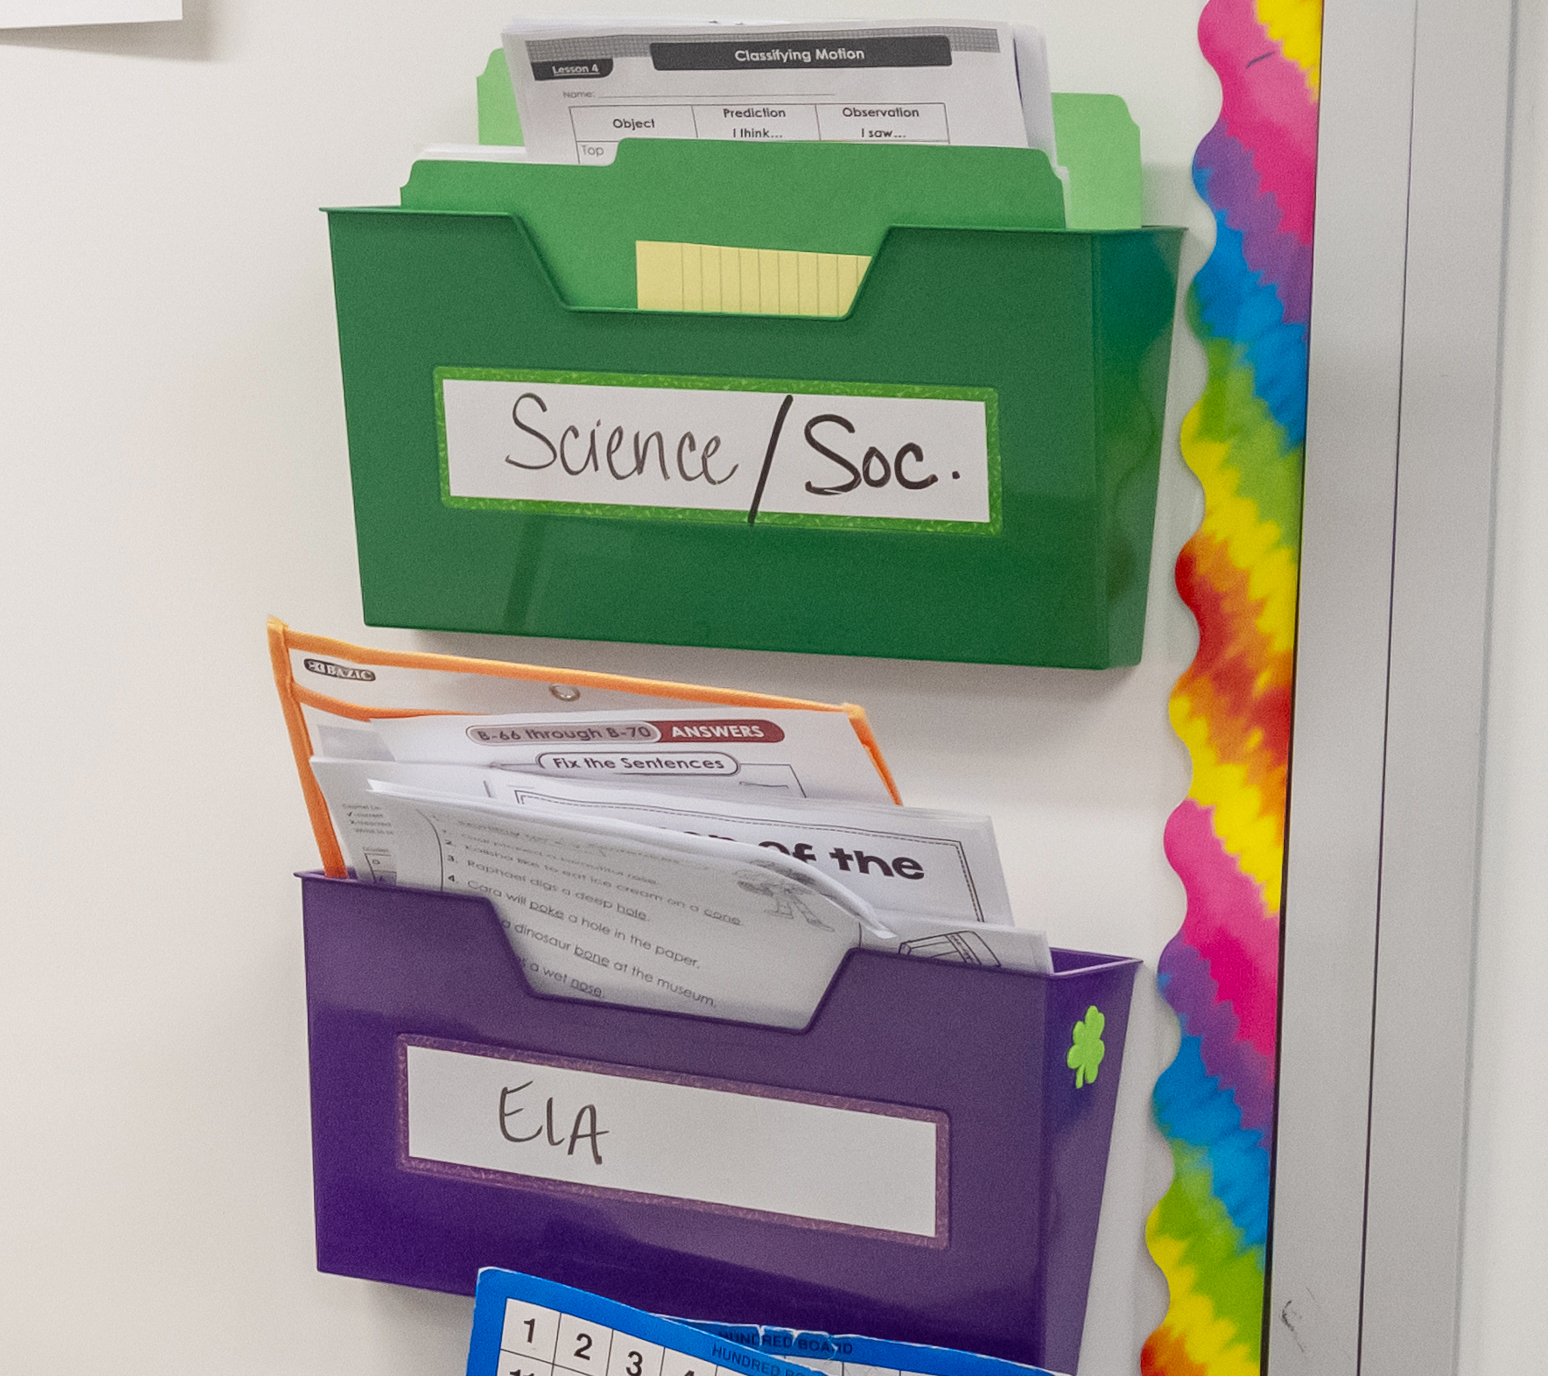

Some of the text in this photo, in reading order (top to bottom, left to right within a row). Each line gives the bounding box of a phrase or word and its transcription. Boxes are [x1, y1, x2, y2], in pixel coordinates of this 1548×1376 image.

[735, 48, 865, 63] Classifying Motion
[552, 64, 600, 75] Lesson 4
[562, 91, 595, 99] Name:
[723, 107, 786, 119] Prediction
[842, 107, 919, 118] Observation
[612, 119, 655, 130] Object
[581, 145, 605, 158] Top
[478, 724, 765, 743] B-66 through B-70 ANSWERS
[553, 755, 725, 770] Fix the Sentences
[829, 847, 924, 880] the
[467, 880, 700, 969] Cara will poke a hole in the paper.
[498, 1080, 610, 1165] ELA
[524, 1319, 536, 1343] 1
[574, 1333, 593, 1360] 2
[712, 1344, 780, 1376] HUNDRED
